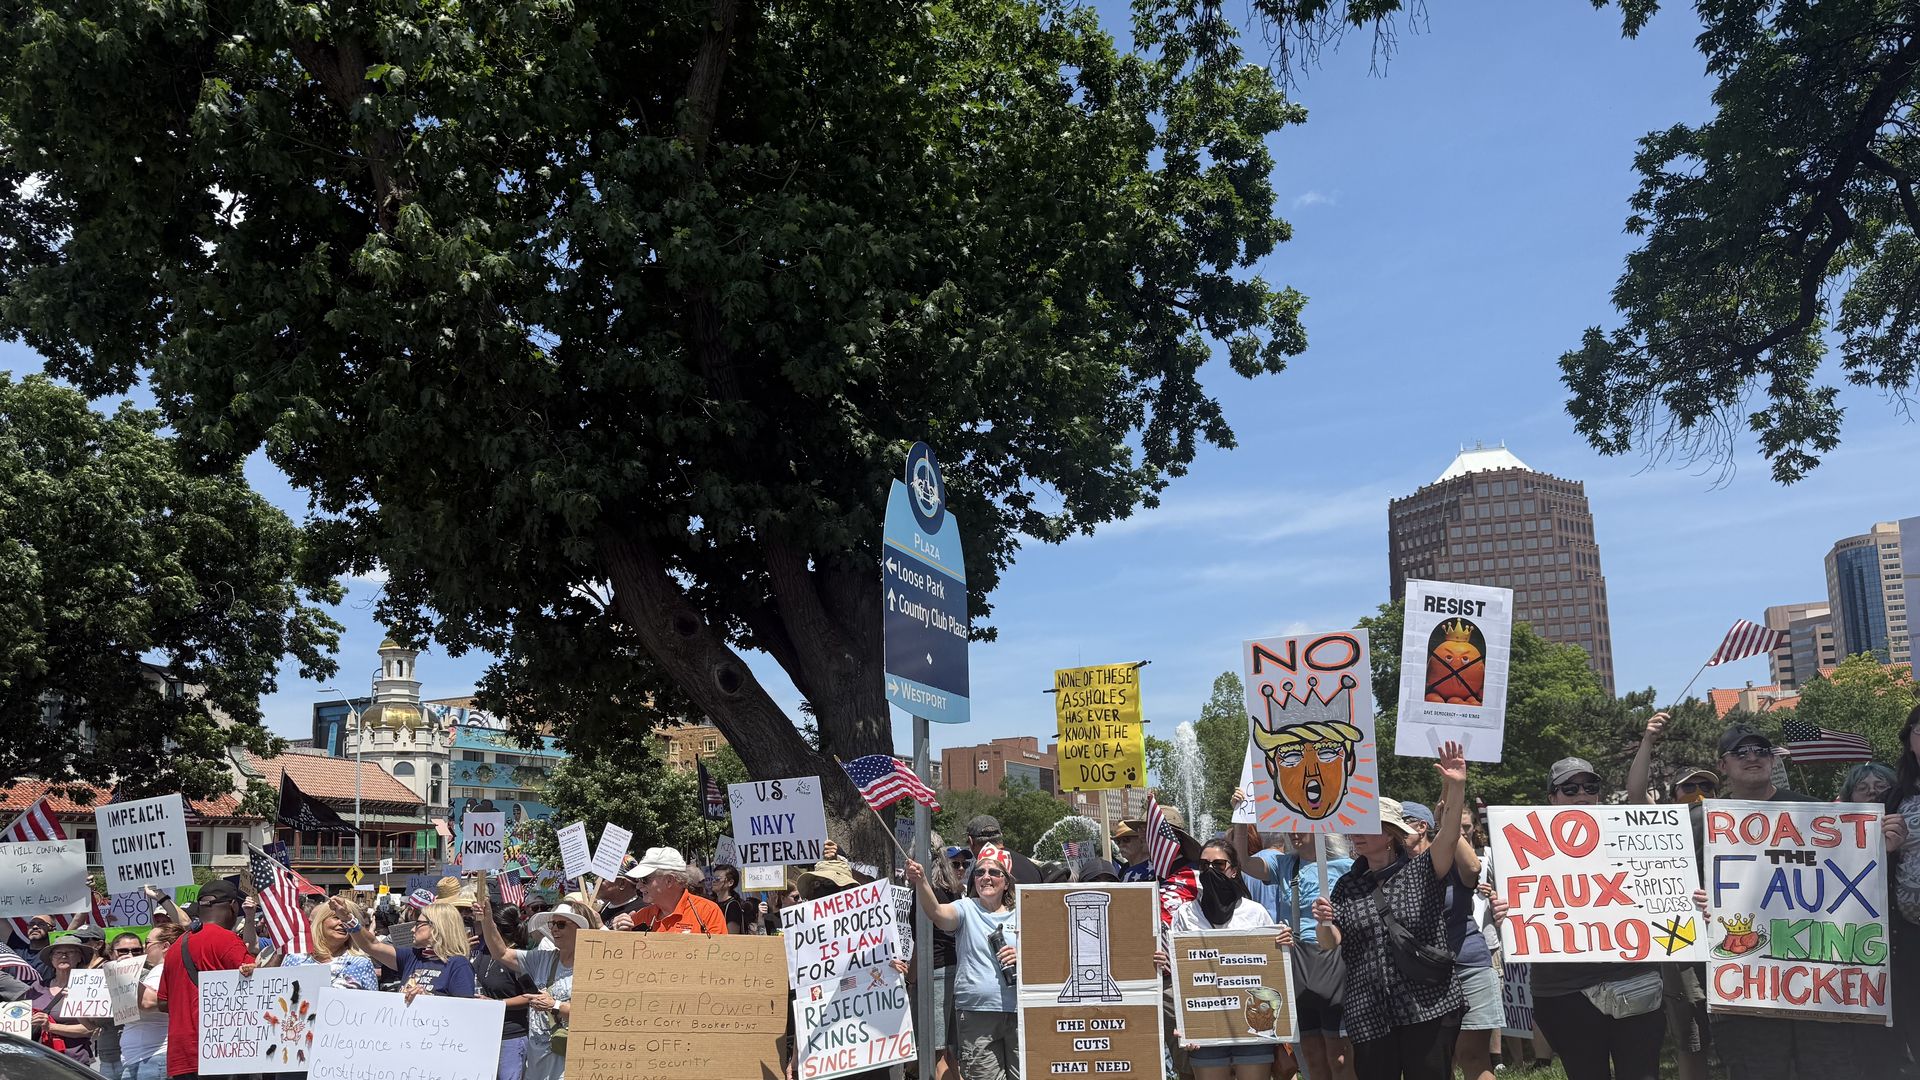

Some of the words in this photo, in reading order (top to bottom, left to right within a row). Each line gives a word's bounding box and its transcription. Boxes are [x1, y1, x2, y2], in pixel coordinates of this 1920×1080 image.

[914, 532, 940, 561] PLAZA
[897, 560, 924, 590] Loose
[926, 574, 945, 600] Park
[1424, 595, 1486, 617] RESIST
[898, 594, 930, 629] Country
[930, 607, 948, 632] Club
[948, 616, 967, 640] Plaza
[1252, 632, 1361, 675] NO
[1058, 672, 1081, 688] NONE
[1084, 670, 1094, 686] OF
[1096, 668, 1132, 684] THESE
[901, 682, 947, 711] WESTPORT
[1062, 688, 1126, 710] ASSHOLES
[1066, 710, 1082, 724] HAS
[1088, 708, 1120, 722] EVER
[1066, 725, 1100, 742] KNOWN
[1105, 724, 1128, 739] THE
[1065, 744, 1090, 760] LOVE
[1094, 743, 1109, 758] OF
[1114, 742, 1124, 758] A
[1080, 764, 1116, 782] DOG
[754, 780, 788, 802] U.S.
[107, 803, 169, 828] IMPEACH.
[750, 814, 796, 836] NAVY
[1625, 810, 1679, 826] NAZIS
[473, 822, 495, 836] NO
[1706, 811, 1877, 848] ROAST
[112, 831, 172, 854] CONVICT.
[464, 840, 501, 854] KINGS
[1502, 809, 1600, 870] NO
[1618, 834, 1684, 851] FASCISTS
[13, 846, 32, 856] WILL
[738, 839, 820, 864] VETERAN
[1764, 850, 1817, 866] THE
[32, 864, 43, 874] BE
[118, 859, 176, 881] REMOVE!
[1626, 857, 1688, 877] tyrants
[1506, 871, 1636, 909] FAUX
[1634, 877, 1685, 896] RAPISTS
[1714, 854, 1880, 918] FAUX
[20, 895, 34, 904] WE
[782, 906, 805, 929] IN
[813, 886, 880, 920] AMERICA
[1646, 896, 1692, 914] LIARS
[795, 924, 826, 950] DUE
[833, 904, 892, 938] PROCESS
[820, 941, 840, 961] IS
[847, 928, 884, 954] LAW
[1770, 918, 1888, 965] KING
[584, 940, 622, 960] The
[632, 940, 676, 960] Power
[686, 950, 699, 960] of
[706, 943, 774, 967] People
[797, 959, 836, 984] FOR
[848, 942, 897, 970] ALL!!
[1189, 950, 1198, 959] If
[1199, 950, 1218, 959] Not
[1220, 955, 1267, 965] Fascism,
[69, 974, 87, 989] just
[89, 976, 104, 988] say
[613, 968, 689, 987] greater
[700, 970, 734, 986] than
[744, 973, 774, 989] the
[1194, 973, 1215, 984] why
[1217, 976, 1261, 986] Fascism
[1504, 962, 1528, 984] UMP
[87, 986, 97, 998] to
[203, 982, 228, 997] EGGS
[234, 980, 254, 996] ARE
[263, 978, 289, 994] HIGH
[1518, 986, 1525, 1004] A
[1714, 963, 1886, 1008] CHICKEN
[203, 996, 248, 1012] BECAUSE
[257, 995, 276, 1010] THE
[585, 991, 660, 1013] People
[805, 984, 905, 1029] REJECTING
[1187, 997, 1239, 1009] Shaped??
[203, 1011, 258, 1028] CHICKENS
[324, 1000, 368, 1027] Our
[374, 1007, 449, 1036] Military's
[692, 1020, 730, 1029] Booker
[734, 1022, 758, 1030] D-NJ
[1058, 1021, 1085, 1031] THE
[1090, 1019, 1125, 1030] ONLY
[204, 1028, 224, 1043] ARE
[231, 1026, 250, 1041] ALL
[256, 1026, 270, 1041] IN
[583, 1036, 636, 1051] Hands
[807, 1021, 870, 1054] KINGS
[202, 1041, 259, 1059] CONGRESS!
[320, 1032, 392, 1059] allegiance
[421, 1038, 432, 1050] to
[439, 1037, 468, 1052] the
[805, 1048, 857, 1077] SINCE
[868, 1030, 916, 1064] 1776!
[1074, 1040, 1109, 1050] CUTS
[313, 1058, 394, 1080] Constitution
[593, 1058, 637, 1071] Social
[648, 1057, 712, 1070] Security
[1052, 1062, 1087, 1072] THAT
[1096, 1062, 1130, 1071] NEED
